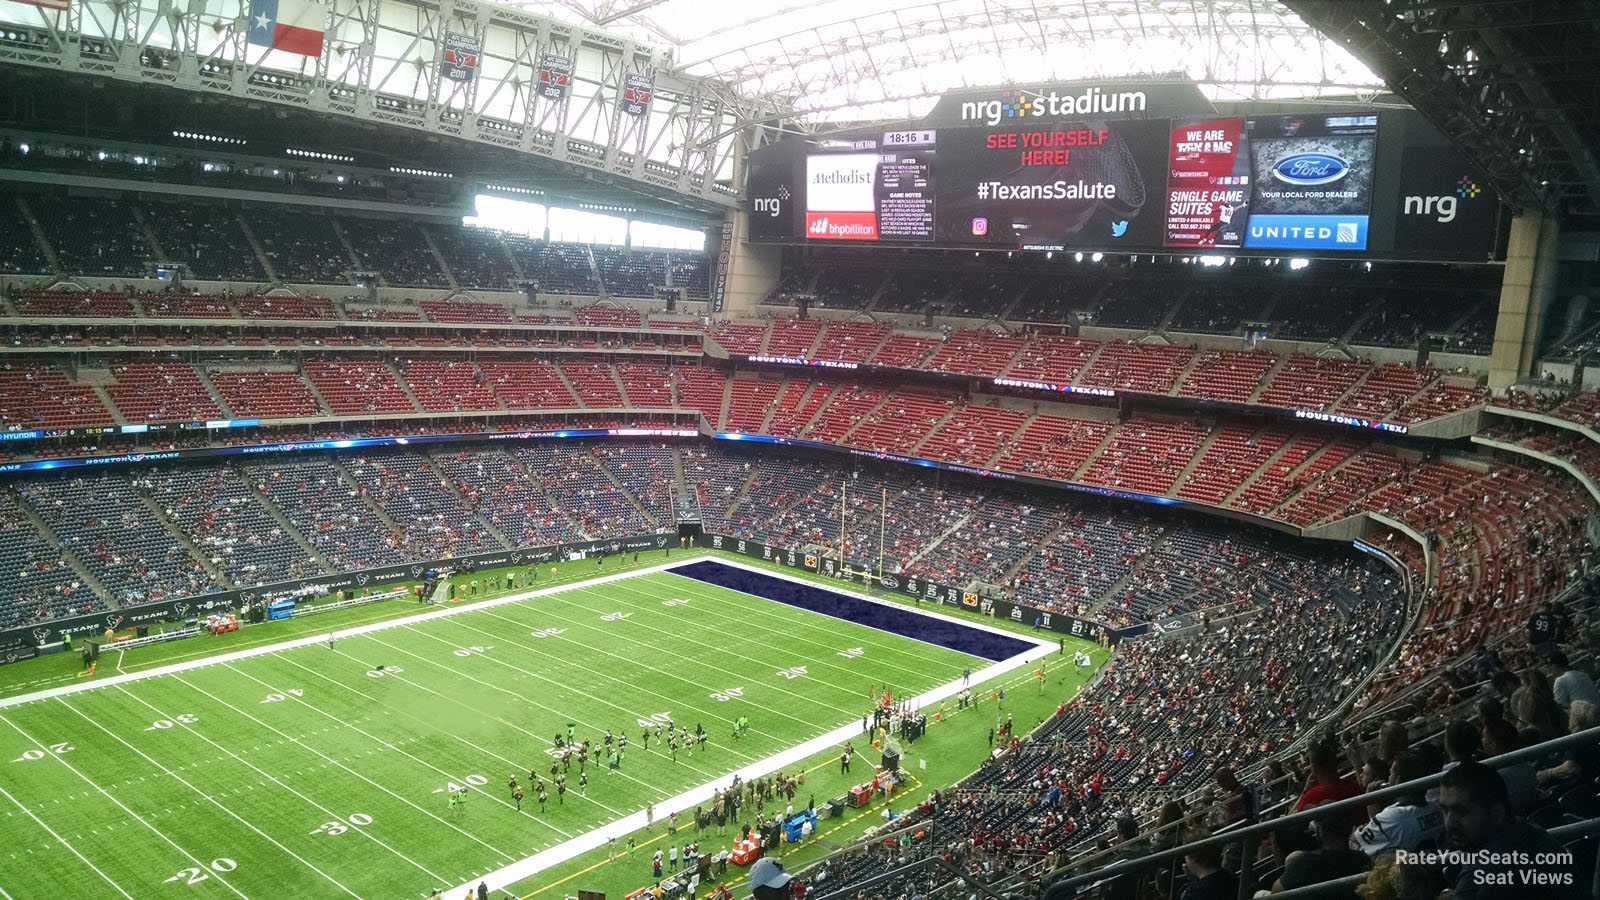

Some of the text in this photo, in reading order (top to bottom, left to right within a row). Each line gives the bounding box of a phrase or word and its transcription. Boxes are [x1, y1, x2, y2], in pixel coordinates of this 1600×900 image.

[450, 68, 466, 79] 2011
[545, 87, 560, 97] 2012
[962, 87, 1146, 126] nrg stadium
[890, 133, 916, 142] 18:16
[987, 128, 1109, 148] SEE YOURSELF
[1186, 130, 1224, 141] WE ARE
[1021, 150, 1070, 166] HERE!
[1290, 160, 1330, 176] Ford
[978, 180, 1115, 200] #TexansSalute
[1170, 191, 1243, 202] SINGLE GAME
[754, 197, 780, 216] nrg
[1170, 202, 1213, 215] SUITES
[1404, 194, 1458, 223] nrg
[829, 224, 874, 236] bhpbilliton
[1252, 226, 1331, 238] UNITED
[994, 379, 1115, 396] HOUSTON TEXANS
[1296, 411, 1352, 424] HOUSTON
[375, 572, 405, 580] TEXANS
[908, 583, 916, 591] 46
[948, 592, 957, 601] 75
[131, 610, 168, 621] TEXANS
[600, 612, 624, 621] 20
[1011, 610, 1022, 618] 29
[1043, 617, 1050, 625] 11
[1536, 620, 1548, 631] 99
[59, 624, 100, 634] TEXANS
[531, 628, 557, 638] 30
[1072, 624, 1082, 633] 27
[453, 646, 484, 656] 40
[836, 648, 864, 658] 10
[366, 666, 404, 678] 50
[776, 666, 808, 679] 20
[266, 689, 303, 701] 40
[709, 688, 743, 702] 30
[153, 714, 199, 728] 30
[637, 713, 670, 727] 40
[23, 742, 75, 759] 20
[448, 775, 488, 792] 40
[320, 813, 373, 835] 30
[176, 858, 237, 885] 20
